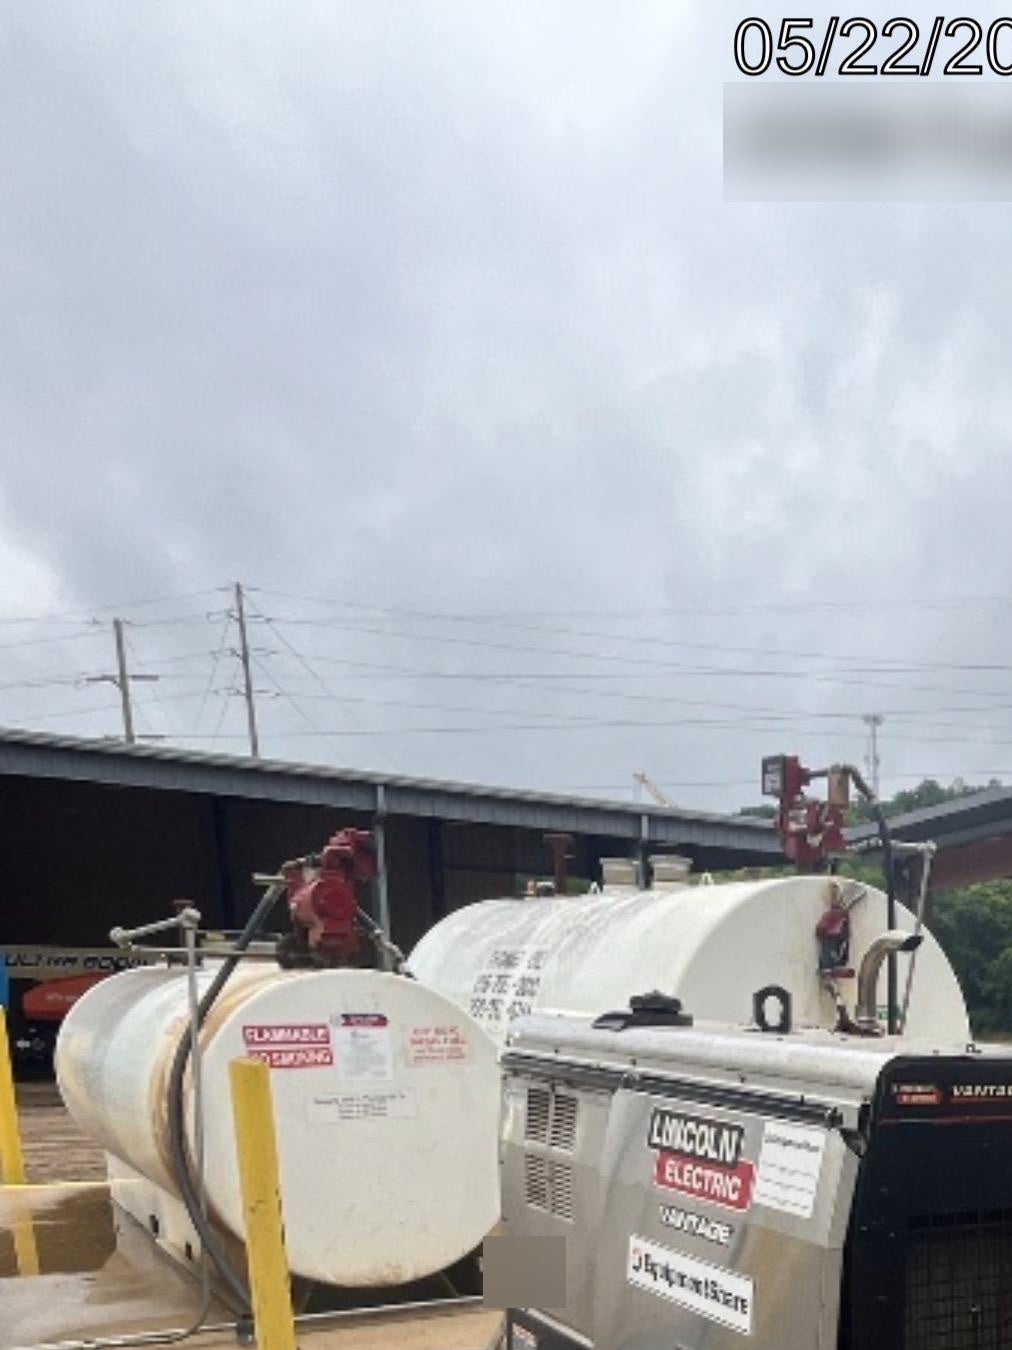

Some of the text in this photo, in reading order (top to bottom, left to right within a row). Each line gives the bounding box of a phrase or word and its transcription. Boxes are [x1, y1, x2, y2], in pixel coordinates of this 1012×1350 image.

[245, 1027, 329, 1042] FLAMMABLE
[651, 1112, 738, 1162] LINCOLN
[665, 1159, 741, 1201] ELECTRIC
